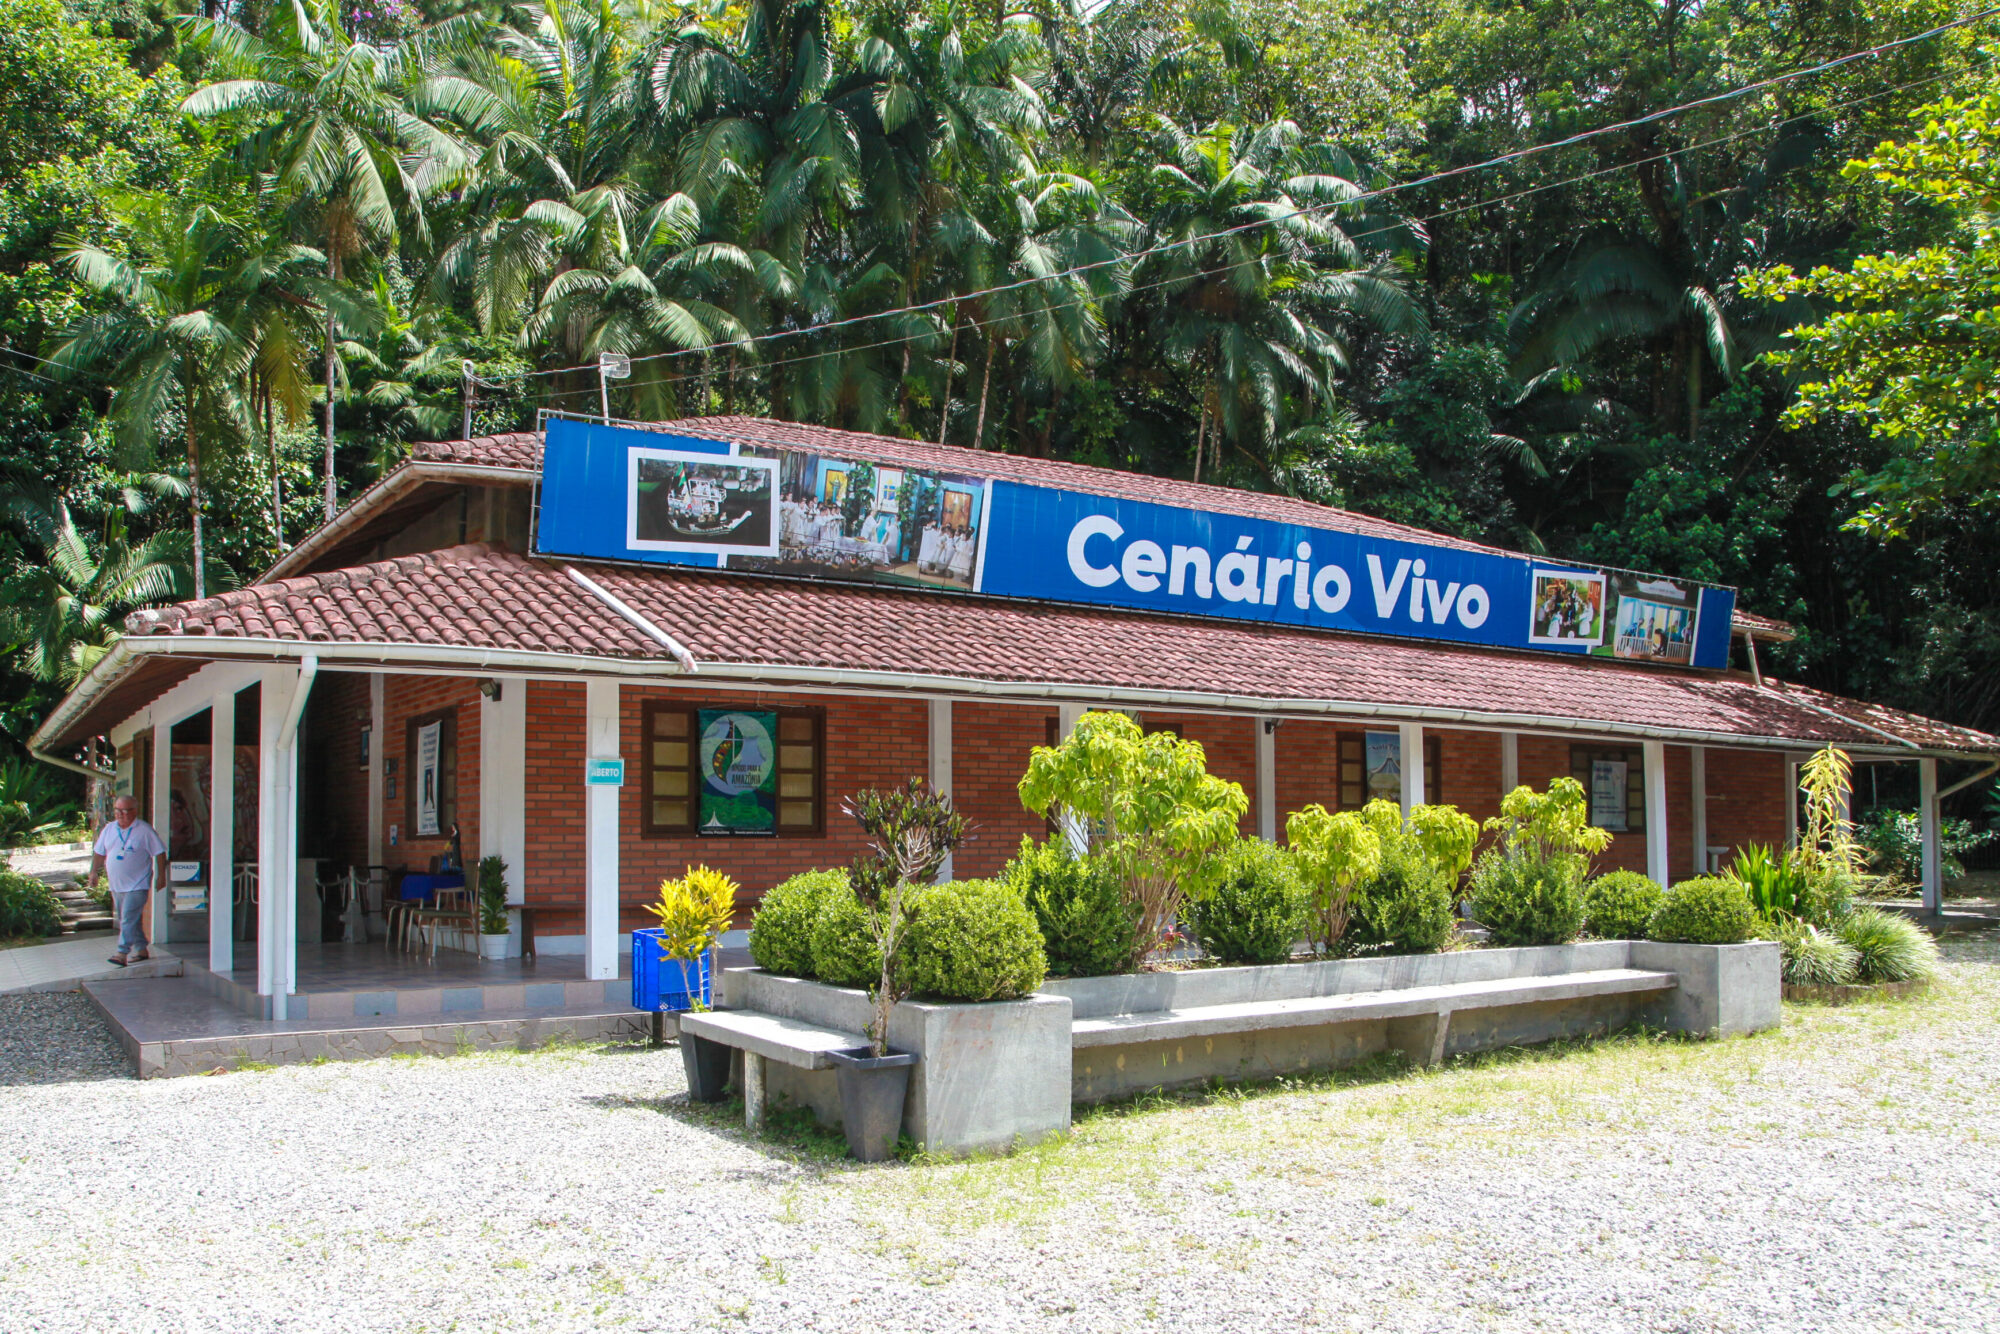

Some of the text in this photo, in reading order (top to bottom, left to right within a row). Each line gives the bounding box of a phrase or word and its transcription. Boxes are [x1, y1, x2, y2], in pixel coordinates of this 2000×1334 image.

[1067, 515, 1490, 630] Cenário Vivo
[591, 767, 620, 777] ABERTO
